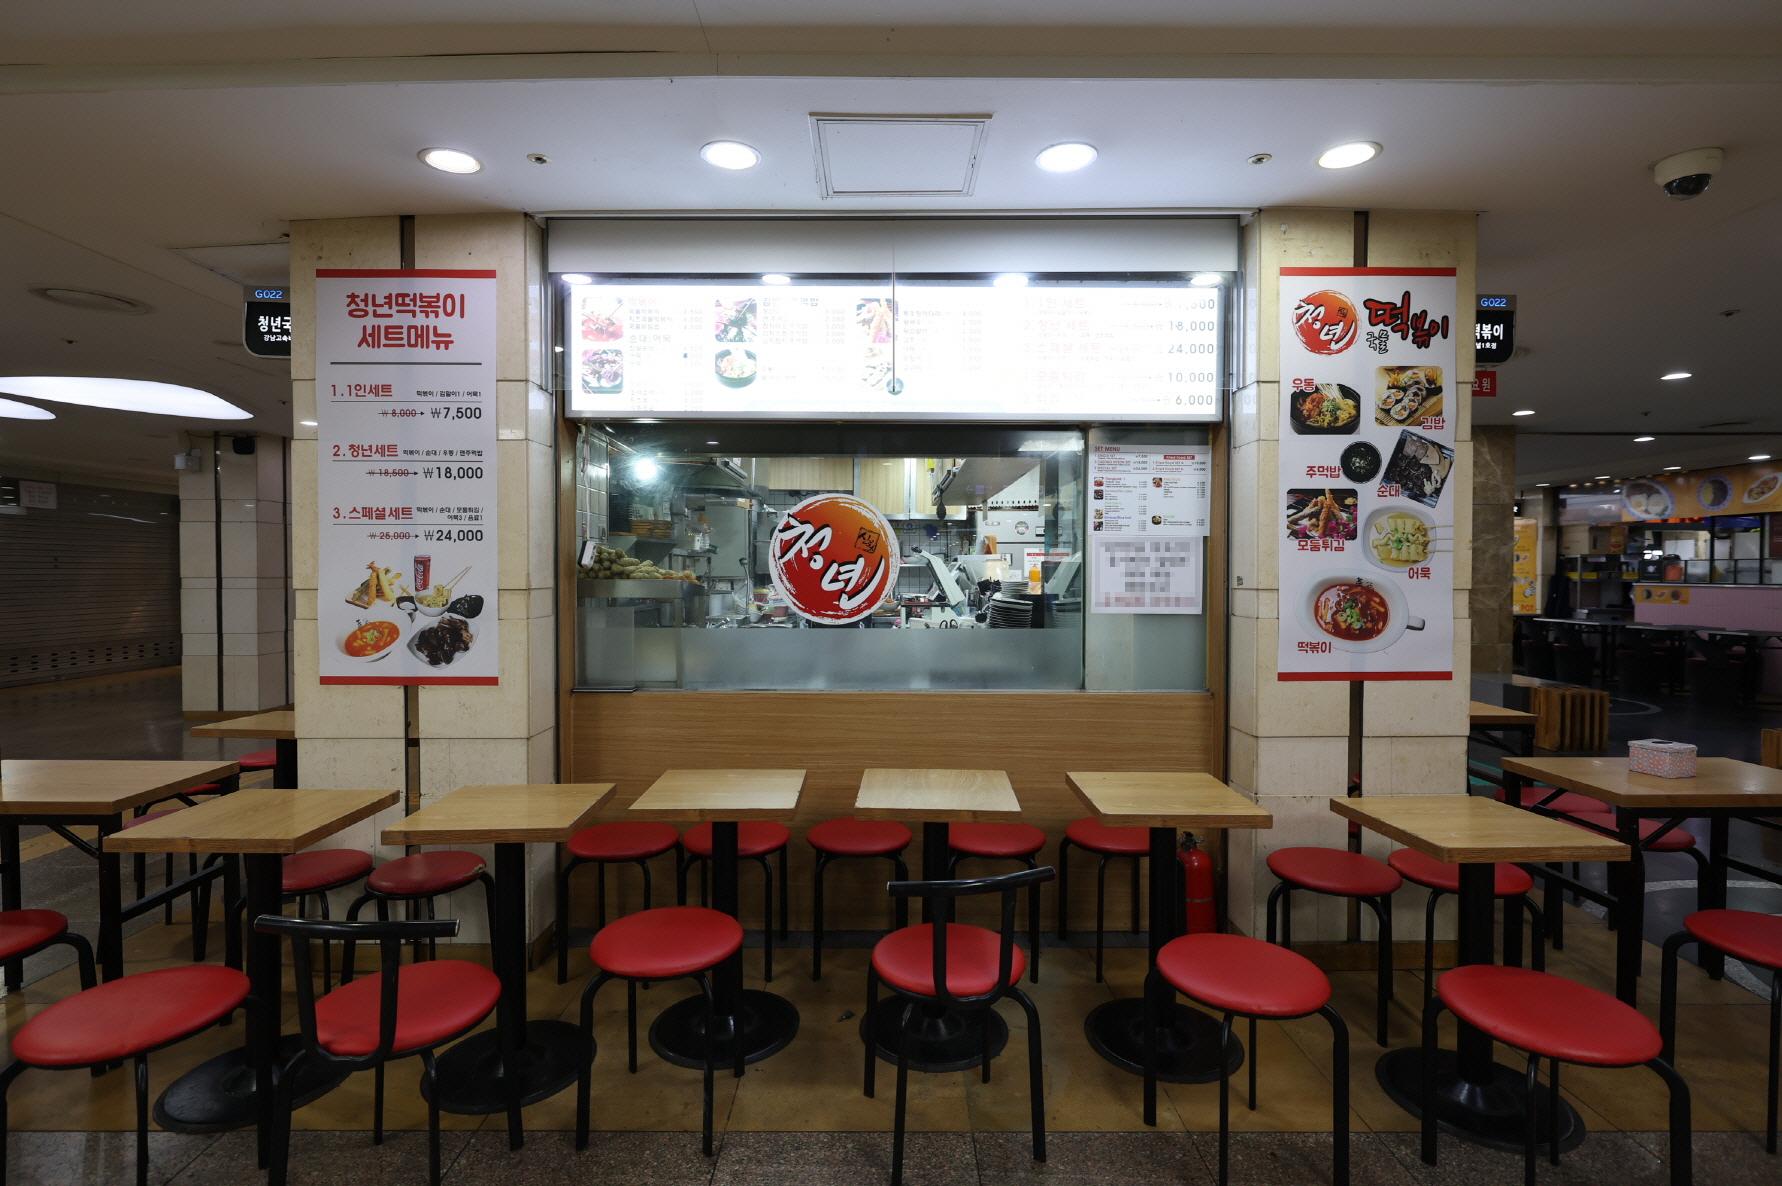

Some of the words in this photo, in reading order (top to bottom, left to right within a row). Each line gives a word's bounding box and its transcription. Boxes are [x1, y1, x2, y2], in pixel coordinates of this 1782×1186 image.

[346, 292, 465, 319] 청년떡볶이
[1363, 290, 1449, 349] 떡볶이
[357, 324, 454, 350] 세트메뉴
[1366, 329, 1389, 354] 국물
[1291, 377, 1315, 392] 우동
[1421, 416, 1446, 430] 김밥
[1305, 465, 1342, 479] 주먹밥
[1376, 483, 1401, 498] 순대
[1297, 539, 1345, 552] 모둠튀김
[1408, 567, 1432, 580] 어묵
[1297, 641, 1332, 654] 떡볶이
